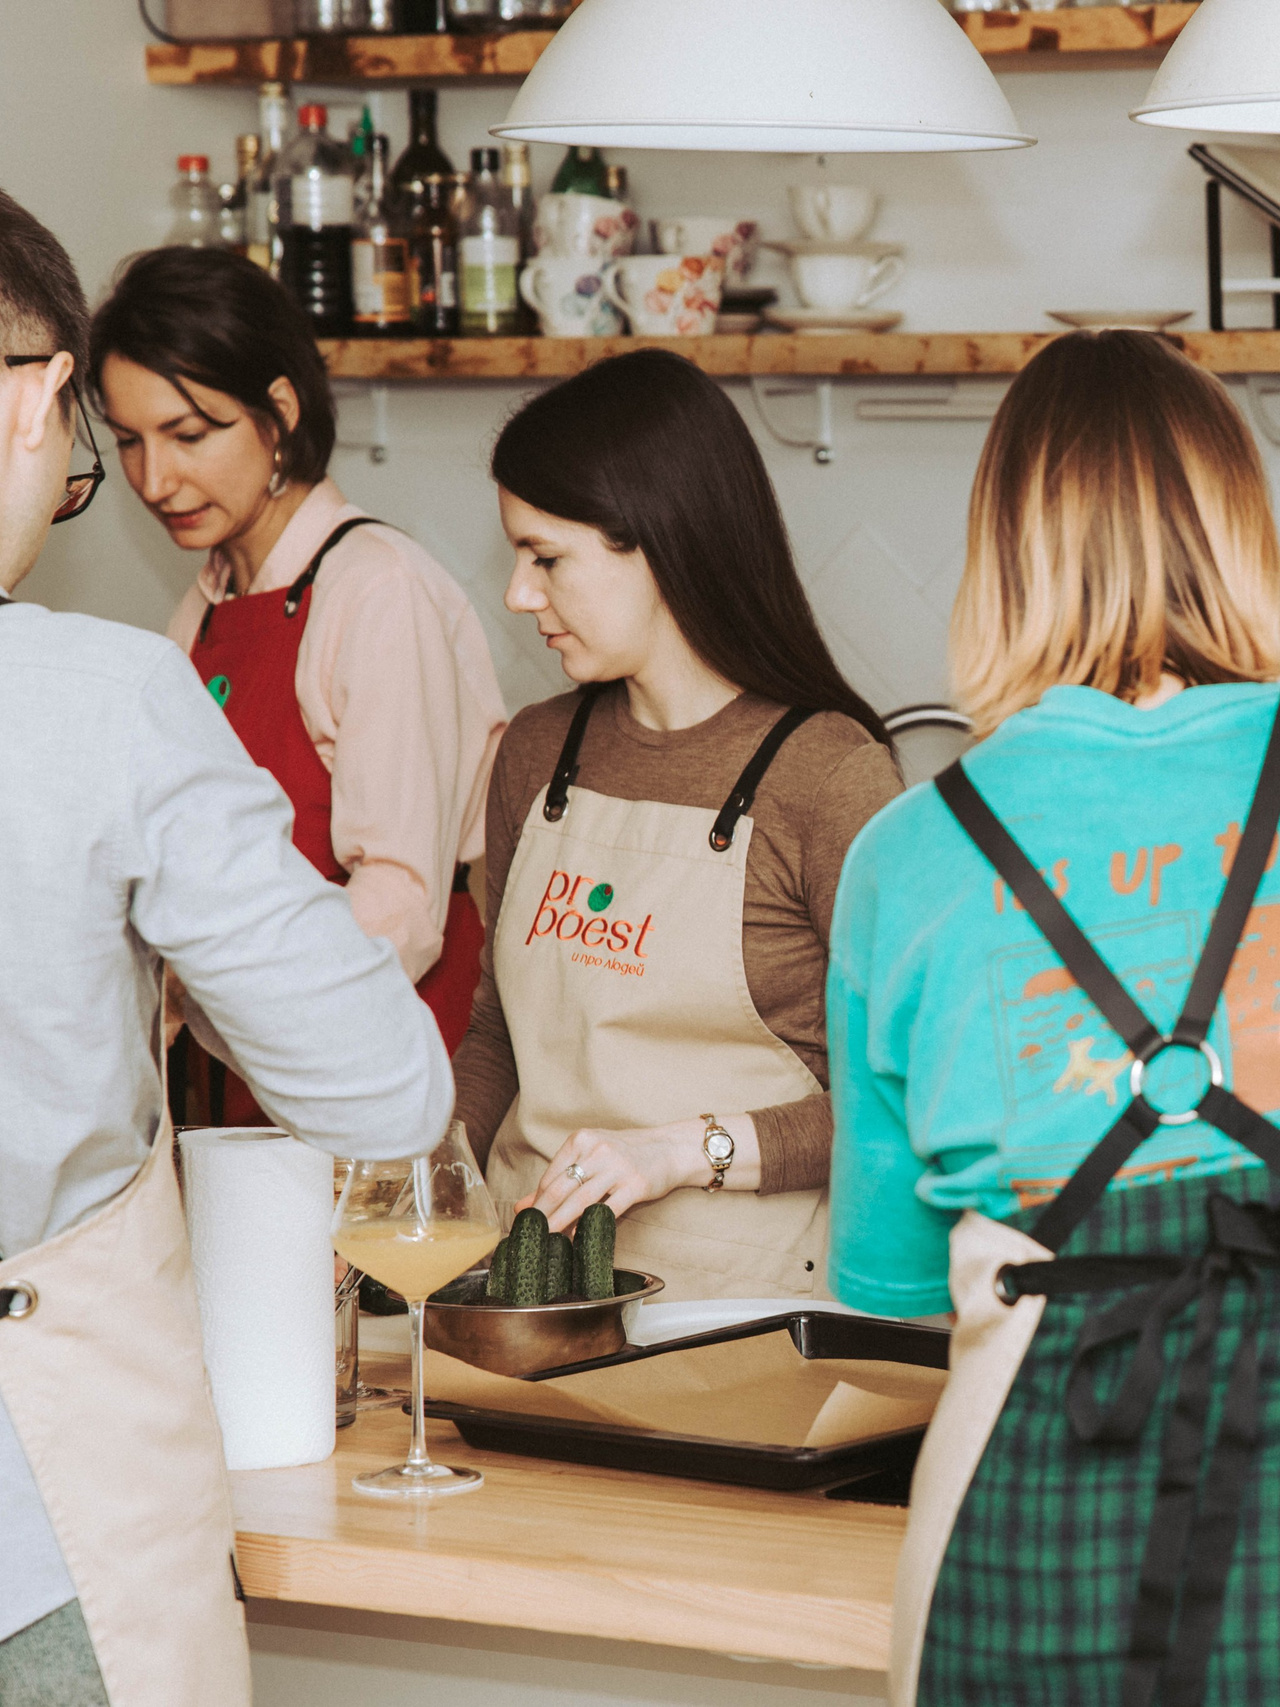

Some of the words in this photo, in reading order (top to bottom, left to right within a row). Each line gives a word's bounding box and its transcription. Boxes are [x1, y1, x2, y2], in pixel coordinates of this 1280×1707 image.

[1110, 844, 1182, 906] up
[525, 904, 655, 959] poest
[580, 953, 603, 967] про
